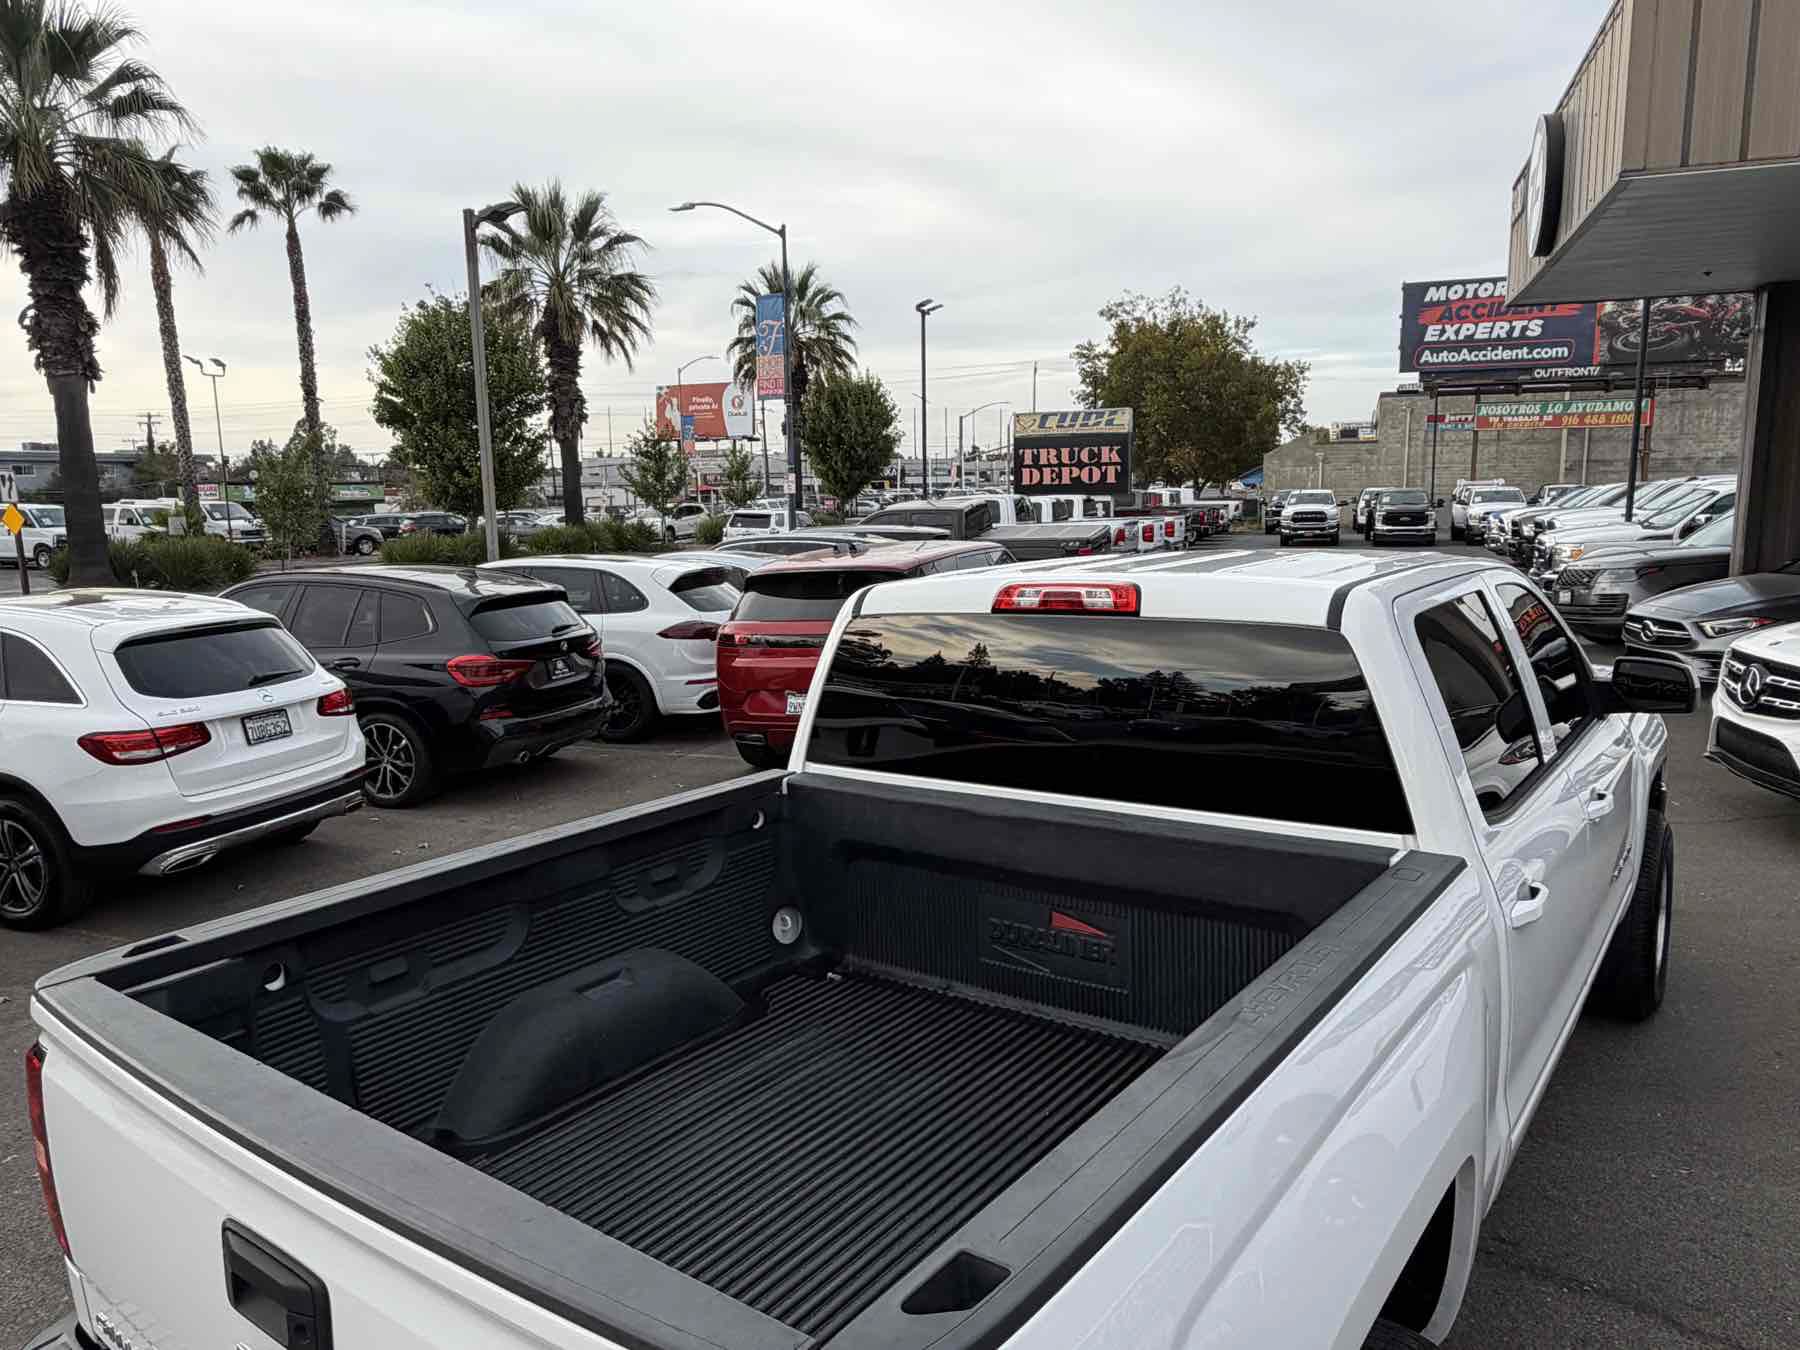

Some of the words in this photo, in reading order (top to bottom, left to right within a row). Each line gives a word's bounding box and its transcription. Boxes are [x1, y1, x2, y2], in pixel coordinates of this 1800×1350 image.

[1423, 319, 1544, 342] EXPERTS
[1419, 345, 1569, 365] AutoAccident.com
[1478, 404, 1540, 416] NOSOTROS
[1547, 403, 1563, 415] LO
[1568, 400, 1646, 414] AYUDAMO
[1561, 416, 1580, 426] 916
[1019, 445, 1122, 465] TRUCK
[1021, 465, 1121, 485] DEPOT
